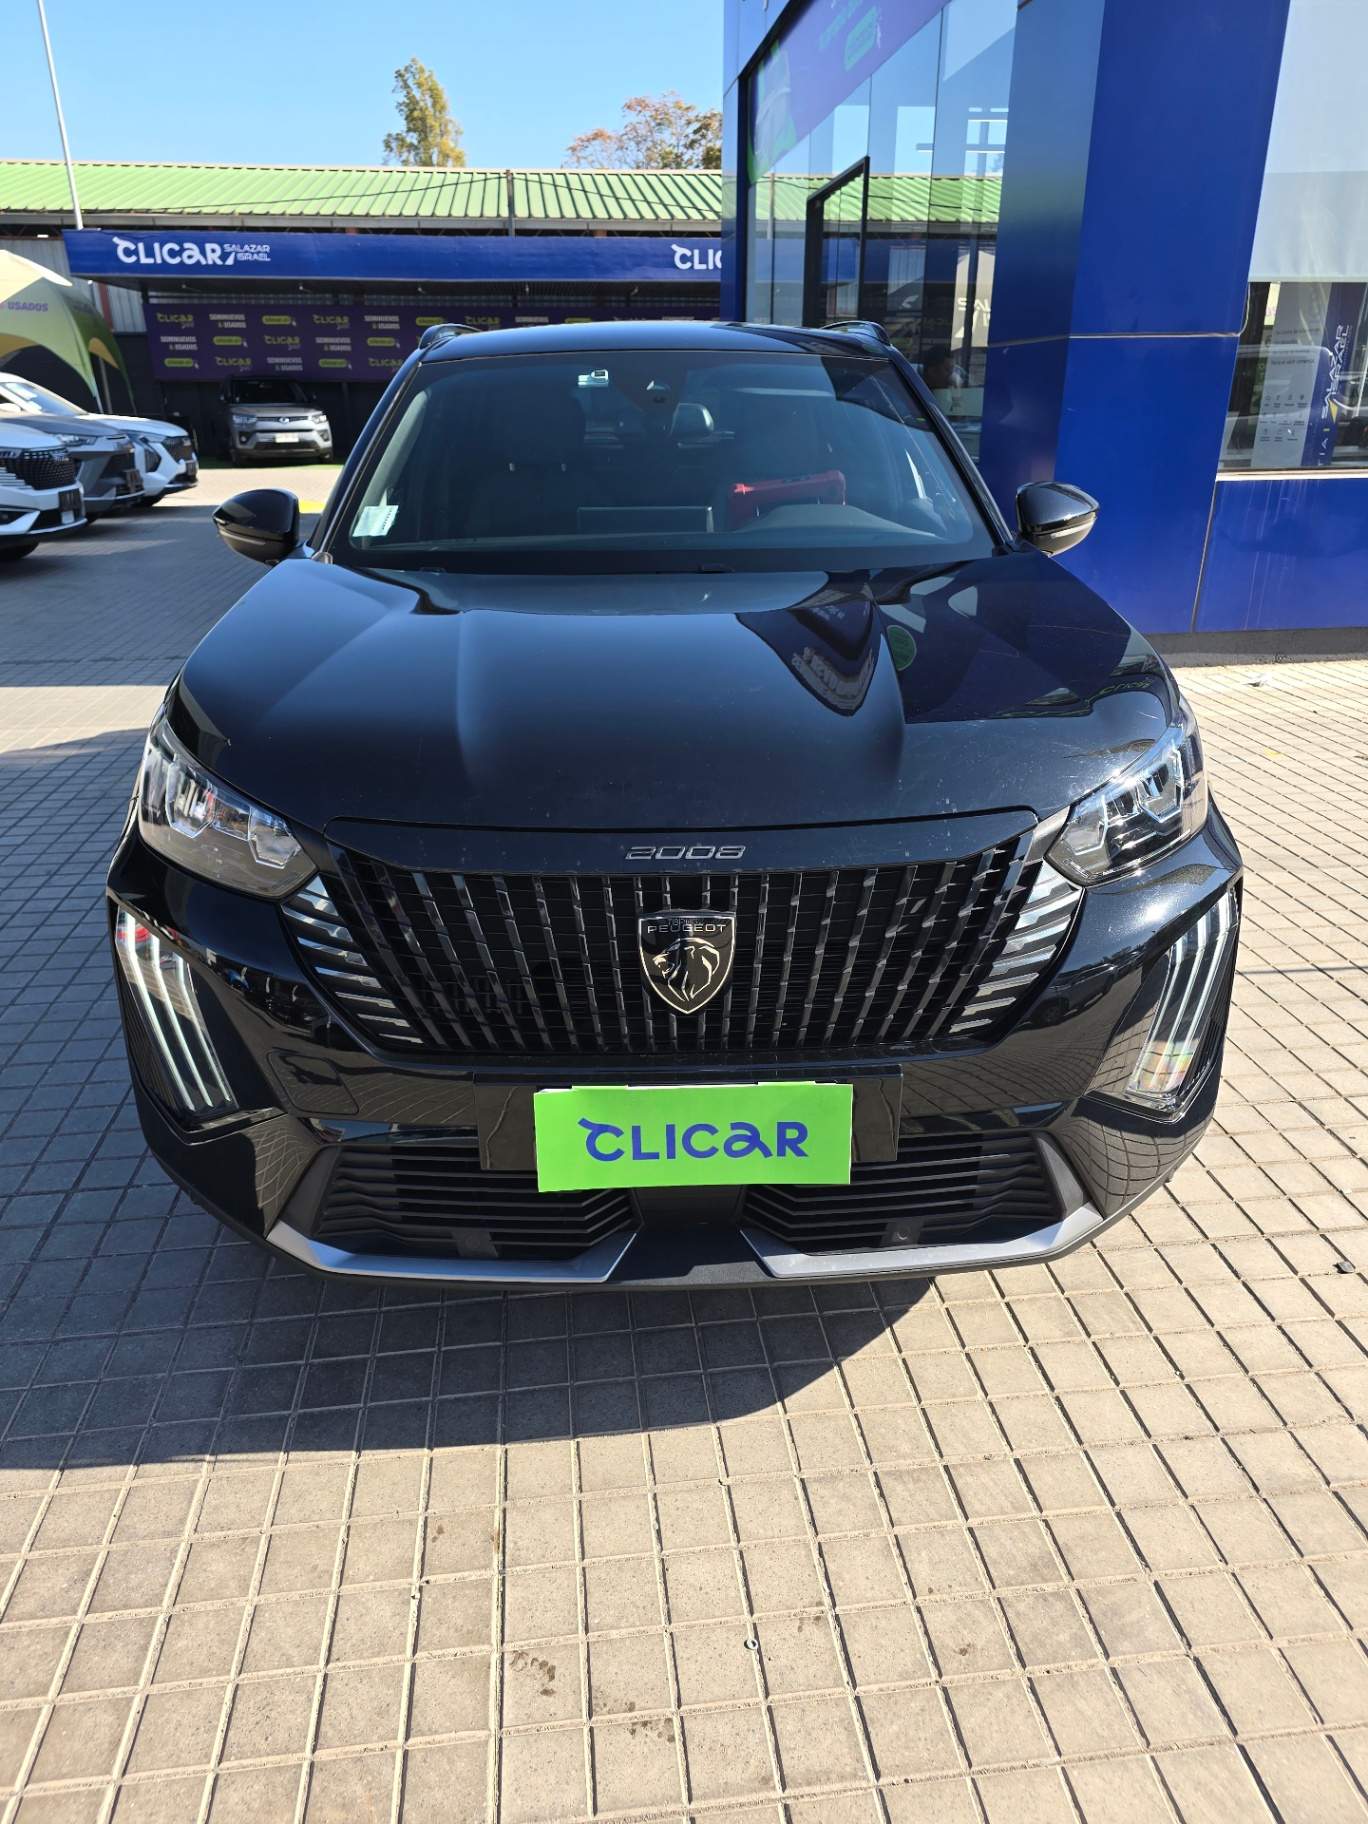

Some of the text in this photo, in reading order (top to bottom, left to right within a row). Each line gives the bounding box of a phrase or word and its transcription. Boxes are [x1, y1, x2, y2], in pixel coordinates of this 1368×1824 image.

[223, 243, 271, 253] SALAZAR
[236, 252, 271, 262] ISRAEL
[7, 301, 49, 312] USADOS
[624, 845, 746, 861] 2008
[646, 922, 727, 934] PEUGEOT
